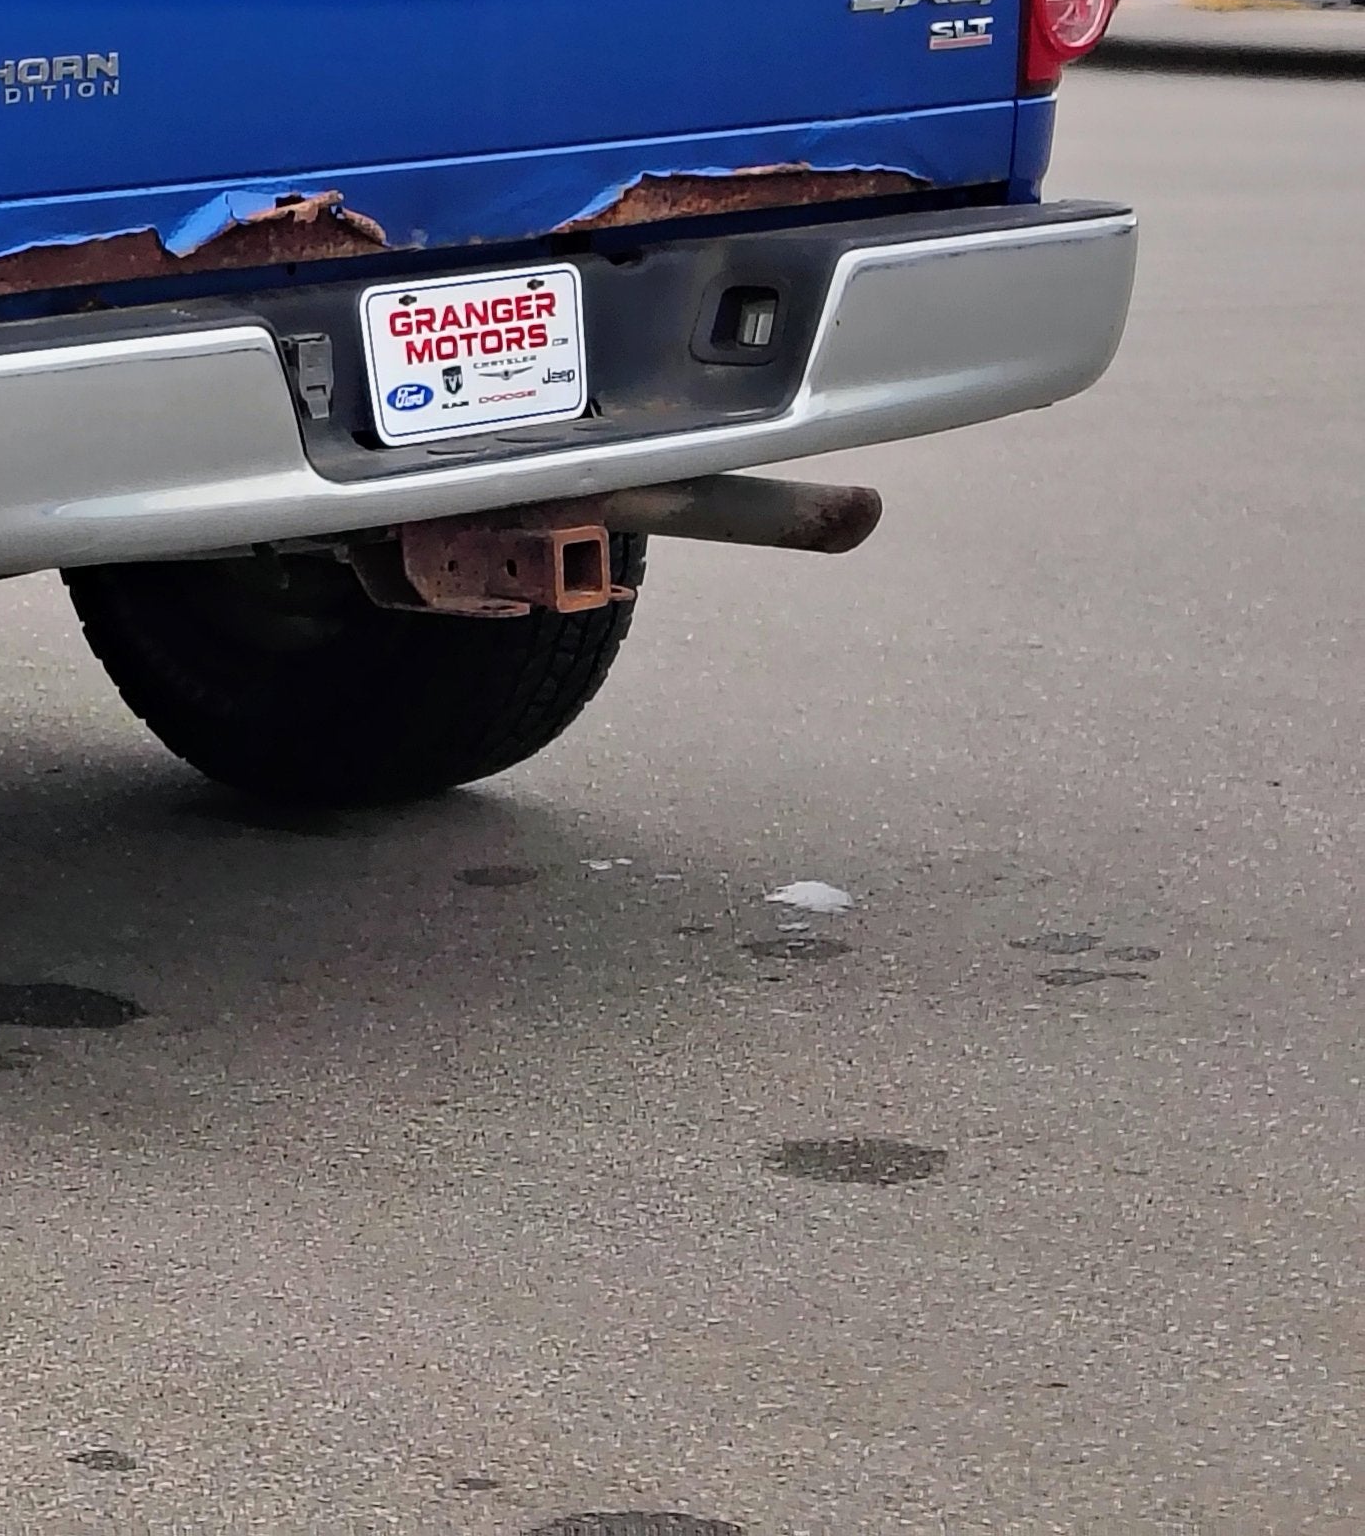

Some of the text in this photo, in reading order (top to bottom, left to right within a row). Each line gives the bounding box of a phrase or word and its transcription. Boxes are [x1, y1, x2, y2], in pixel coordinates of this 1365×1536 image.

[929, 16, 994, 40] SLT
[388, 291, 557, 338] GRANGER
[405, 323, 549, 366] MOTORS
[541, 367, 576, 385] Jeep
[393, 385, 428, 410] Ford
[477, 389, 538, 405] DODGE
